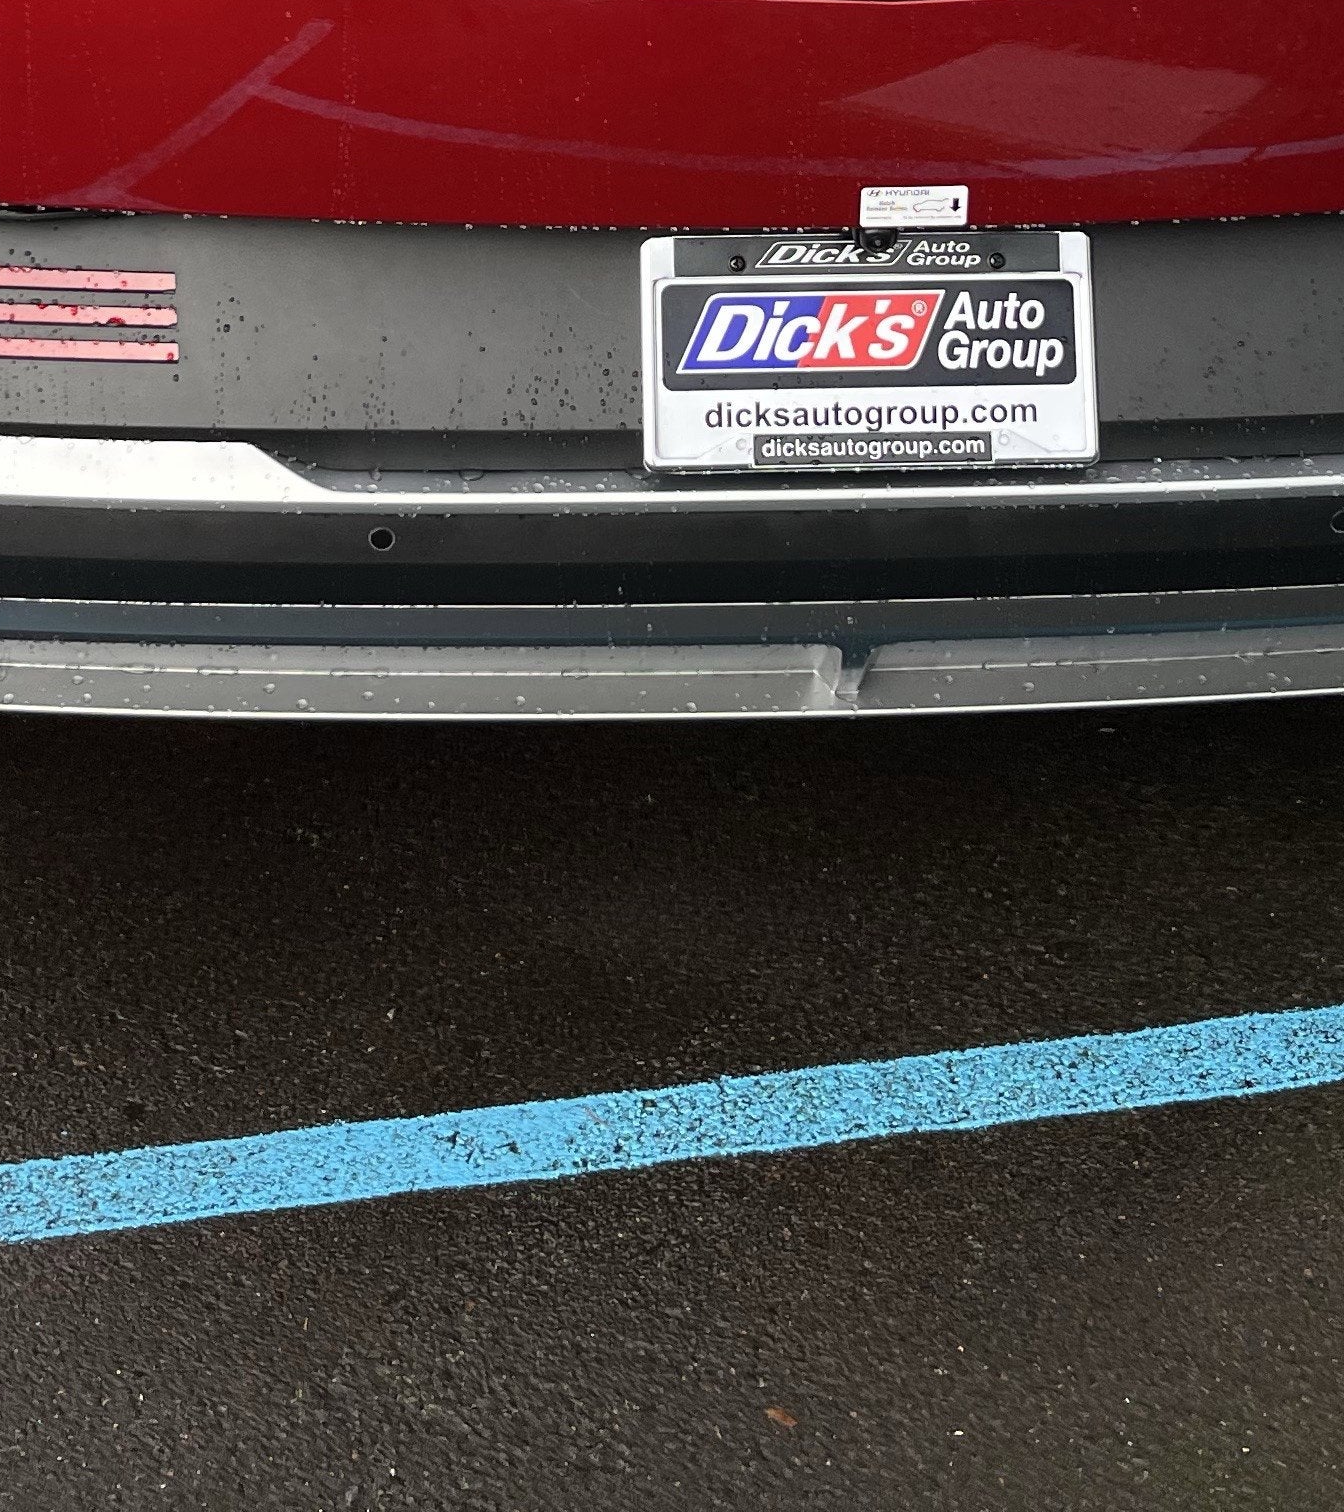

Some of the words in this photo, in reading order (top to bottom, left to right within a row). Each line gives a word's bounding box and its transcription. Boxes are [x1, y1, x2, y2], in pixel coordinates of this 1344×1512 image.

[885, 189, 930, 197] HYUNDAI
[767, 244, 895, 264] Dicks
[913, 240, 971, 254] Auto
[906, 252, 981, 268] Group
[944, 291, 1046, 330] Auto
[695, 299, 916, 363] Dick's
[937, 330, 1065, 377] Group
[705, 399, 1038, 432] dicksautogroup.com
[761, 436, 986, 460] dicksautogroup.com
